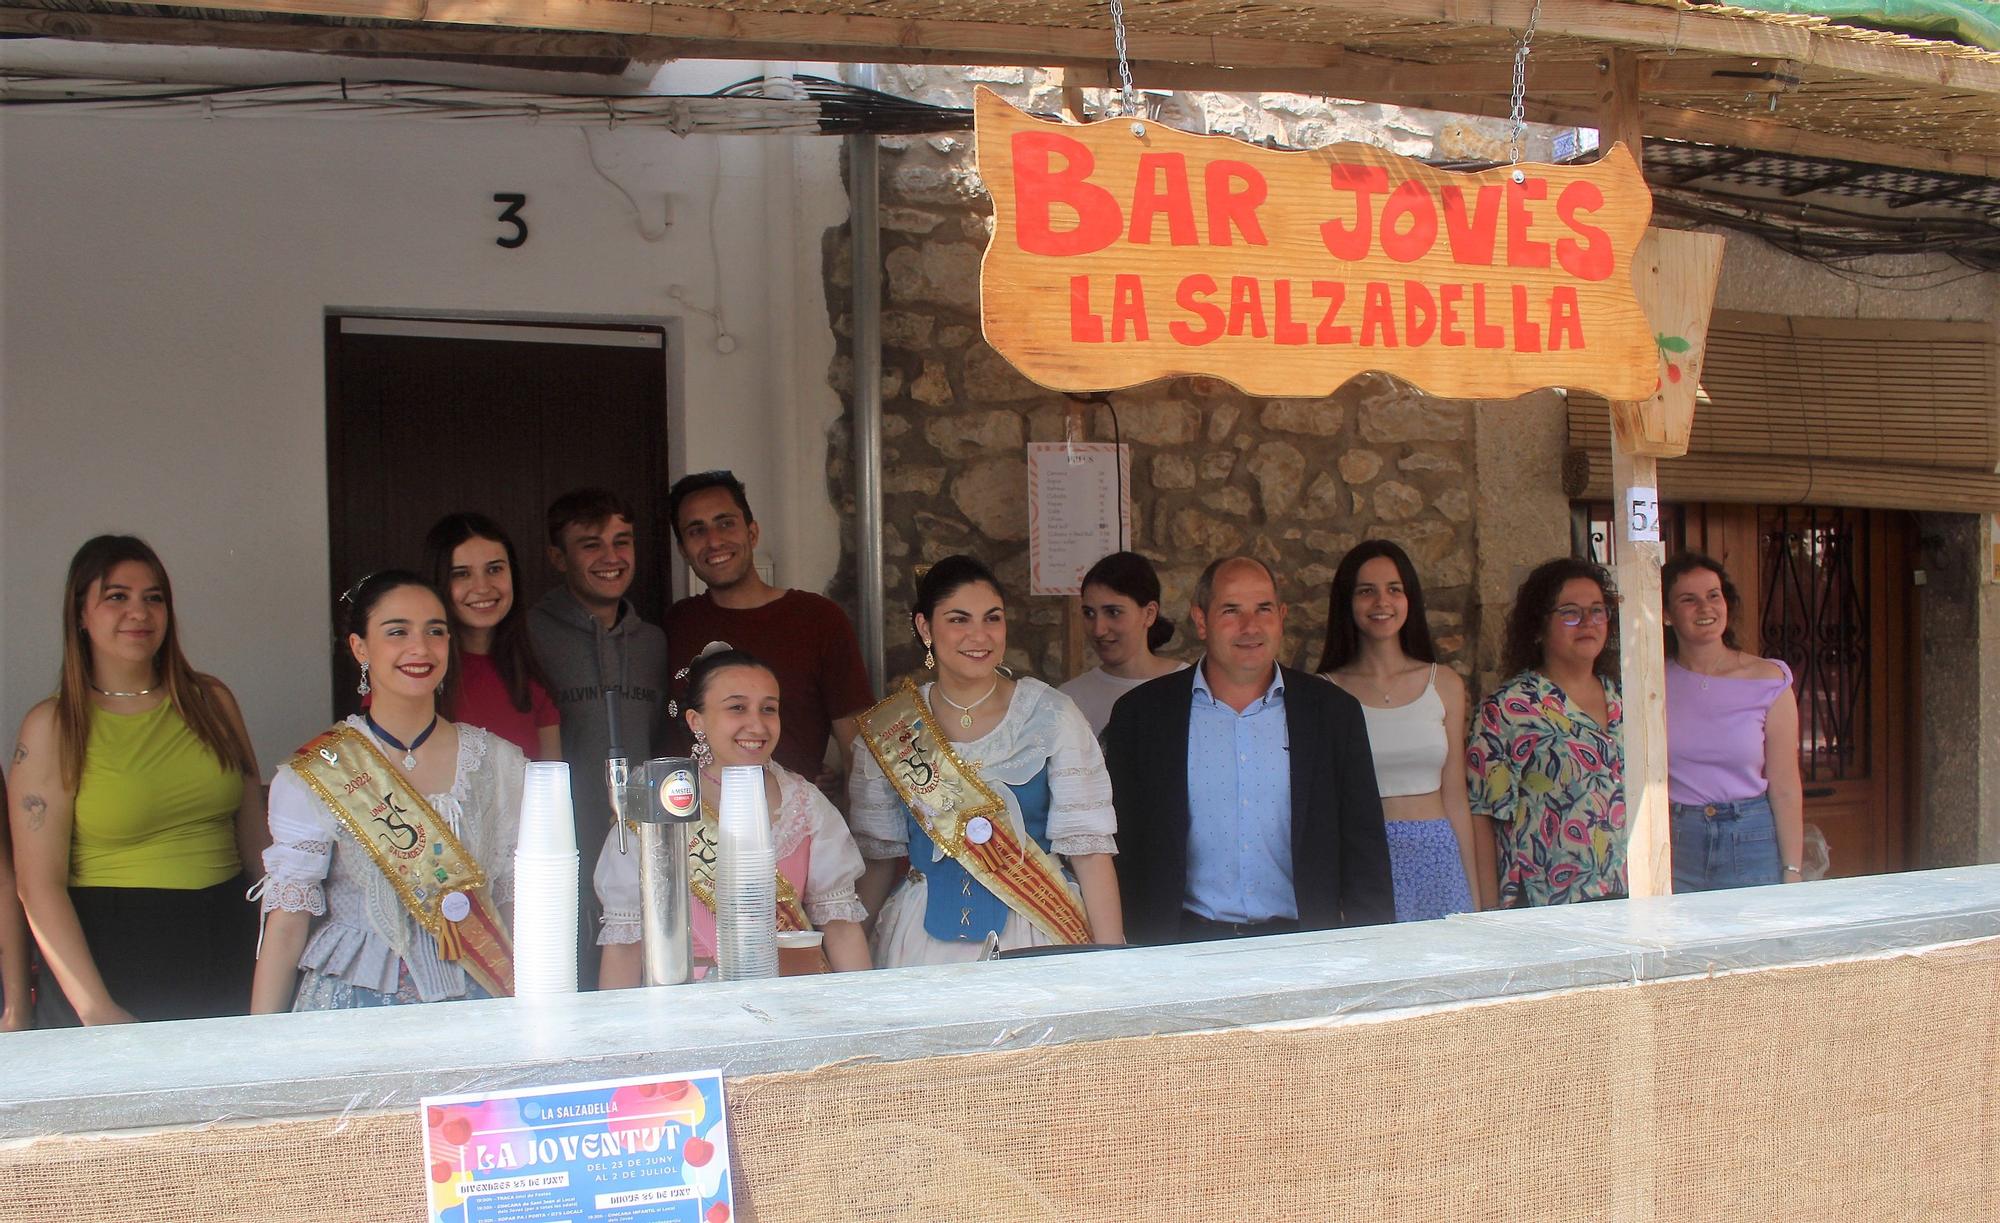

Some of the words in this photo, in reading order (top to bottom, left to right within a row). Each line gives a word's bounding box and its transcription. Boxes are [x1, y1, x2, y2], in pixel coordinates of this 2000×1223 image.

[493, 193, 529, 248] 3
[1011, 130, 1268, 256] BAR
[1321, 163, 1615, 283] JOVES
[1071, 274, 1149, 342] LA
[1169, 274, 1586, 353] SALZADELLA
[343, 772, 372, 795] 2022
[389, 821, 427, 860] SALZADELLENSE
[541, 1107, 554, 1121] LA
[557, 1102, 619, 1119] SALZADELLA
[476, 1142, 518, 1171] LA
[527, 1124, 681, 1166] JOVENTUT
[587, 1163, 608, 1172] DEL
[611, 1160, 624, 1170] 23
[628, 1158, 641, 1167] DE
[645, 1155, 674, 1166] JUNY
[595, 1173, 609, 1182] AL
[622, 1170, 636, 1179] DE
[640, 1166, 679, 1177] JULIOL
